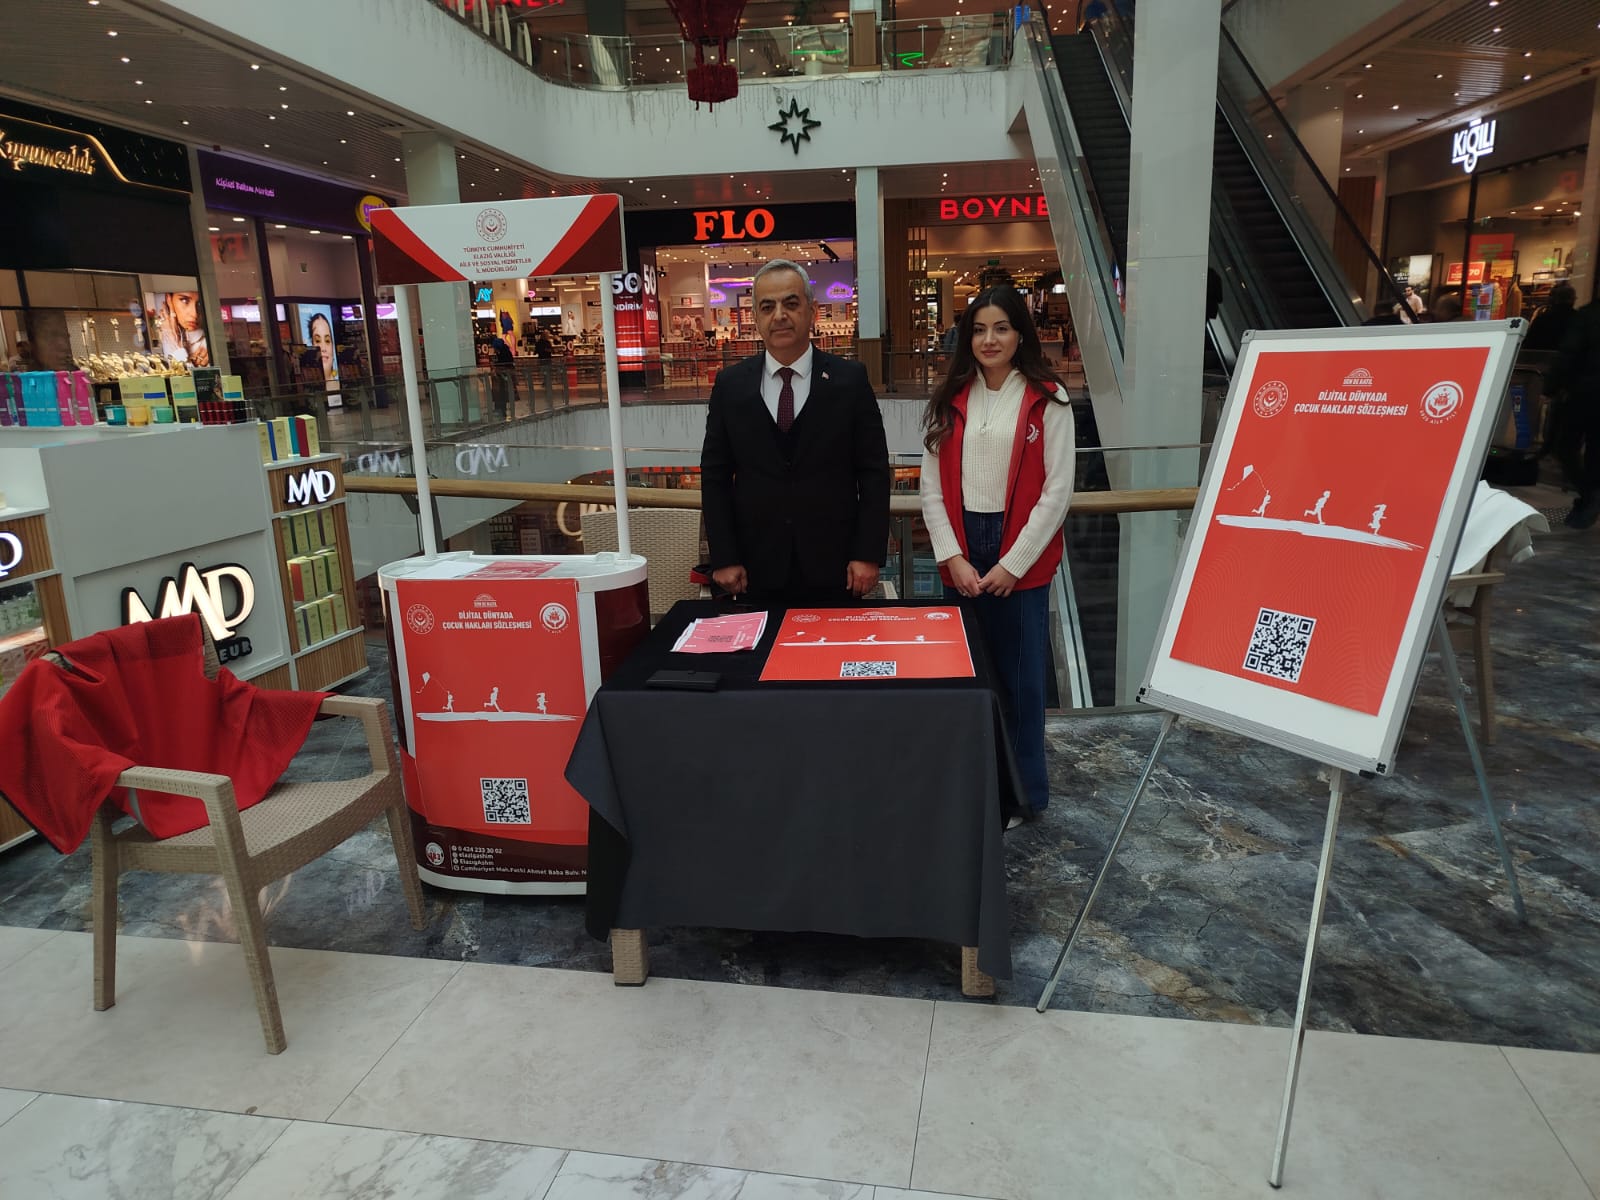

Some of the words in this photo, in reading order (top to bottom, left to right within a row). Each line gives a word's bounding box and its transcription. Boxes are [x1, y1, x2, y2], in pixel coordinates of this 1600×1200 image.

[940, 196, 1049, 220] BOYNE
[693, 208, 775, 241] FLO
[487, 243, 525, 251] CUMHURİYETİ
[501, 257, 532, 265] HİZMETLER
[482, 265, 518, 273] MÜDÜRLÜĞÜ
[1469, 268, 1480, 276] 70
[611, 272, 642, 295] 50
[643, 264, 656, 295] 50
[613, 301, 643, 311] NDİRİM
[1318, 390, 1348, 401] DİJİTAL
[1349, 389, 1387, 402] DÜNYADA
[1294, 403, 1320, 415] ÇOCUK
[1320, 403, 1355, 414] HAKLARI
[1356, 403, 1408, 418] SÖZLEŞMESİ
[287, 467, 336, 505] MAD
[458, 610, 481, 619] DİJİTAL
[482, 610, 514, 619] DÜNYADA
[442, 621, 464, 630] ÇOCUK
[464, 621, 492, 629] HAKLARI
[493, 620, 532, 631] SÖZLEŞMESİ
